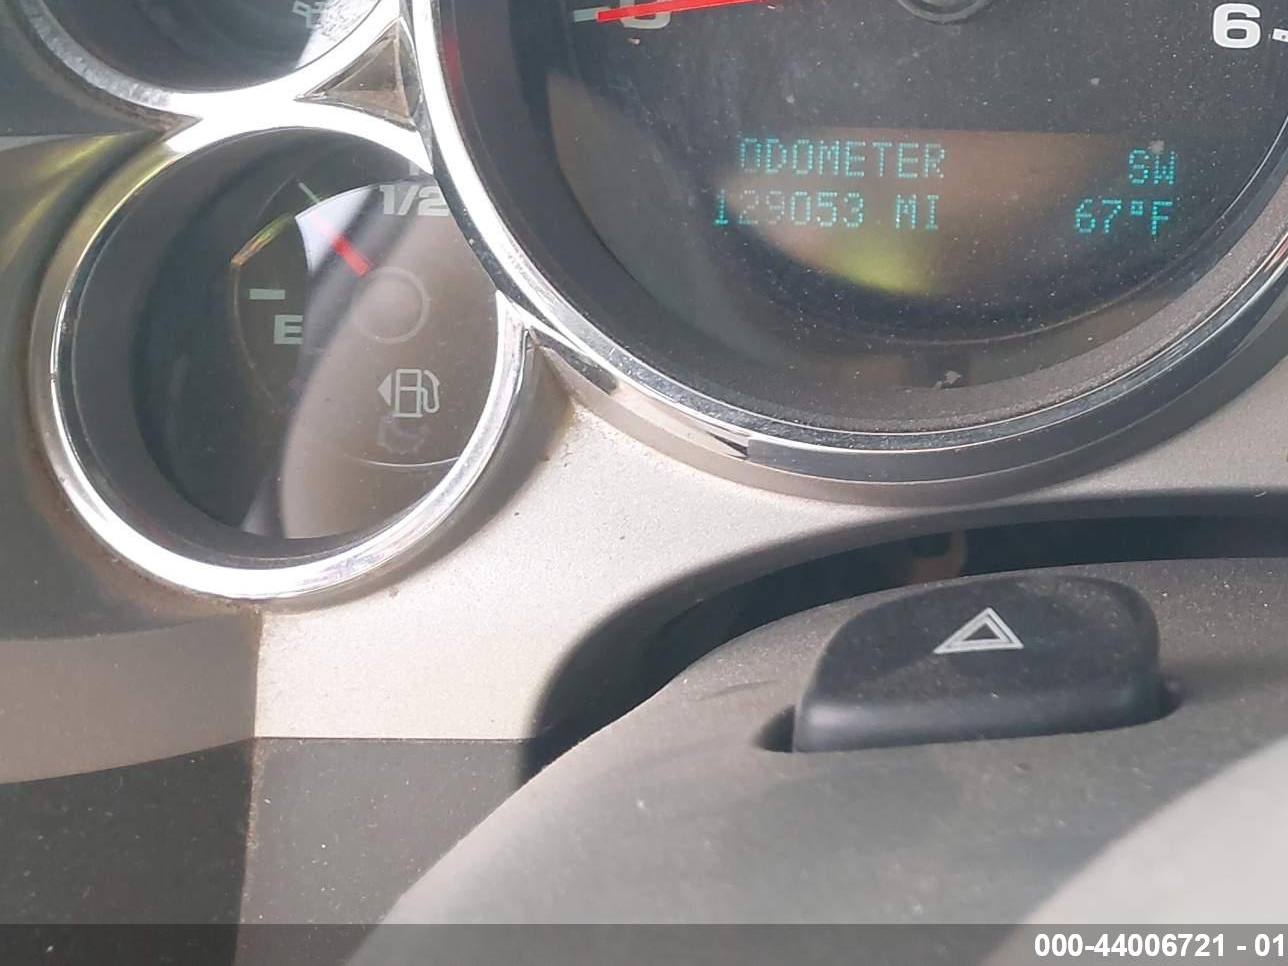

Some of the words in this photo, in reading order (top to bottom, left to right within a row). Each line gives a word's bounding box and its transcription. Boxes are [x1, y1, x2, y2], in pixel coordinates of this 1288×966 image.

[1212, 4, 1261, 49] 6
[740, 137, 945, 178] ODOMETER
[1128, 149, 1175, 185] SW
[379, 184, 450, 217] 1/2
[714, 189, 865, 228] 129053
[895, 194, 940, 229] MI
[273, 314, 304, 344] E
